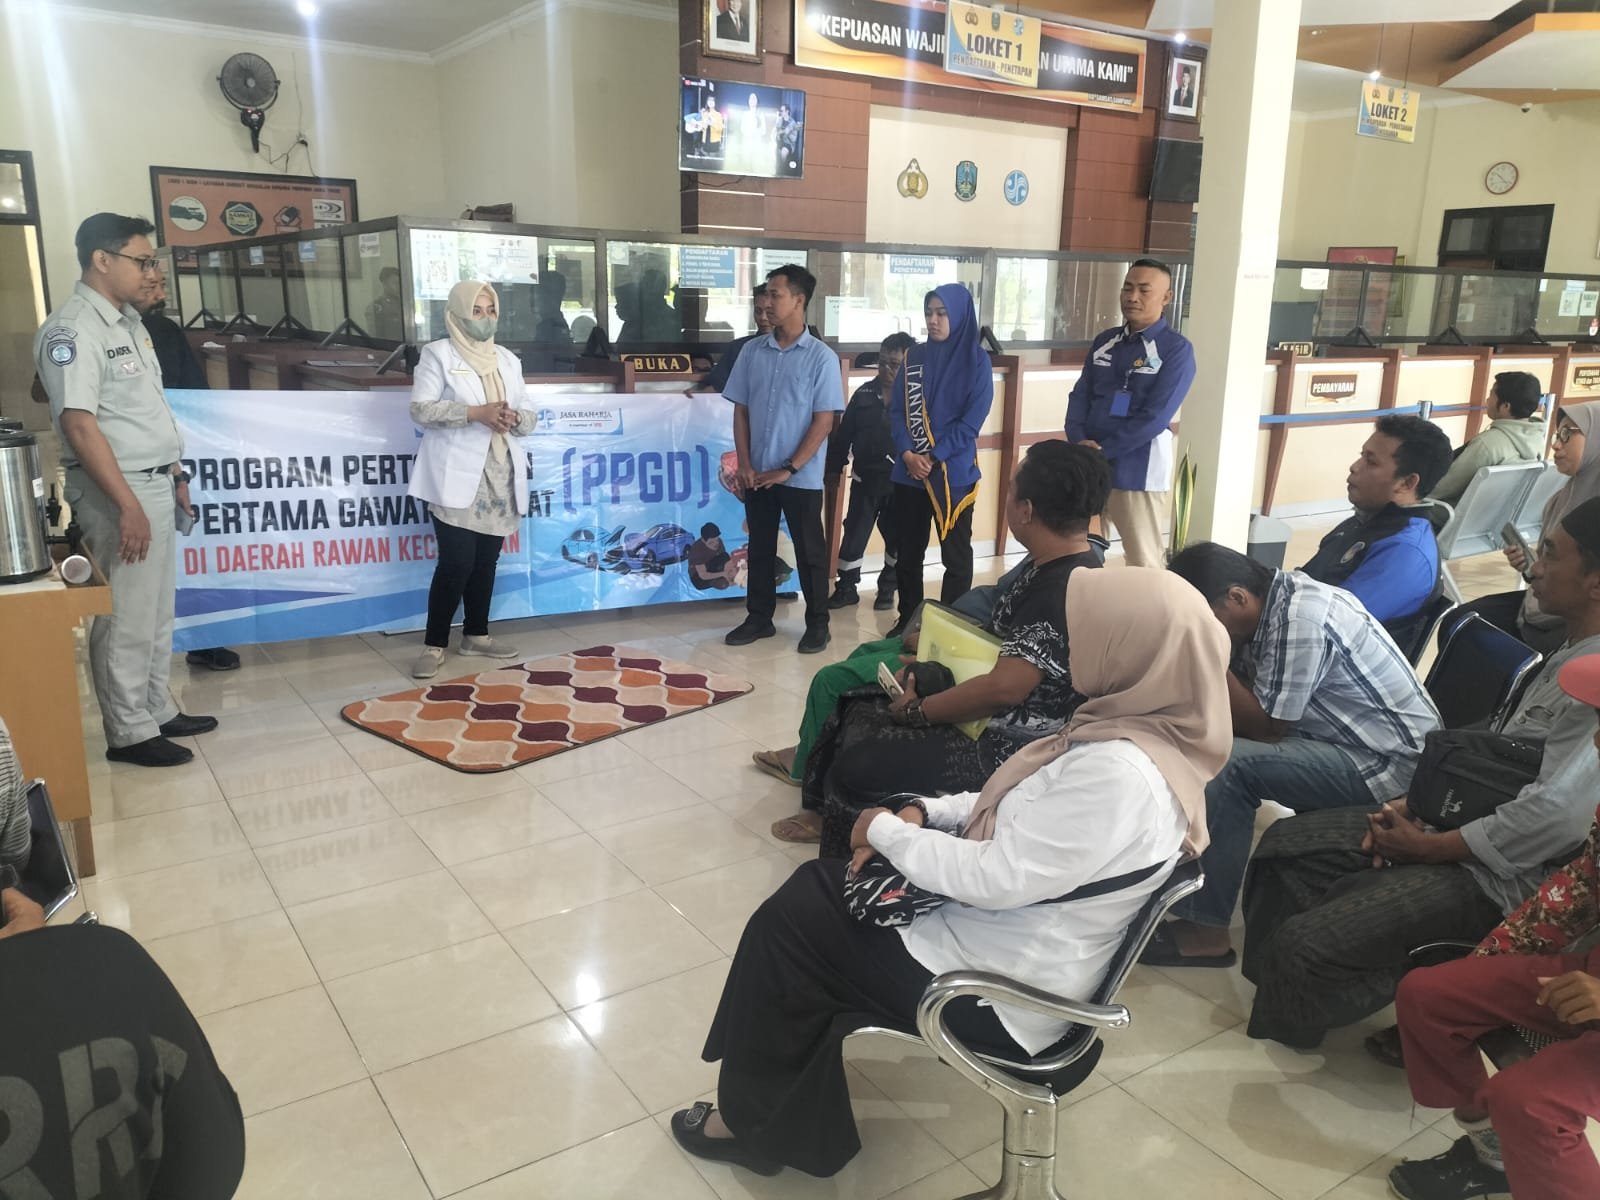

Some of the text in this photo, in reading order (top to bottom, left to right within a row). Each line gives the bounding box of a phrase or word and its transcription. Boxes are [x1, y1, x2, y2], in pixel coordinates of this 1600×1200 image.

[966, 33, 1023, 61] LOKET 1
[1053, 54, 1095, 78] UTAMA
[1371, 102, 1408, 122] LOKET 2
[634, 358, 680, 370] BUKA
[1312, 381, 1355, 394] PEMBAYARAN
[560, 411, 577, 419] JASA
[343, 454, 418, 486] PERT
[563, 444, 710, 514] (PPGD)
[184, 547, 207, 575] DI
[216, 541, 305, 574] DAERAH
[313, 537, 390, 567] RAWAN
